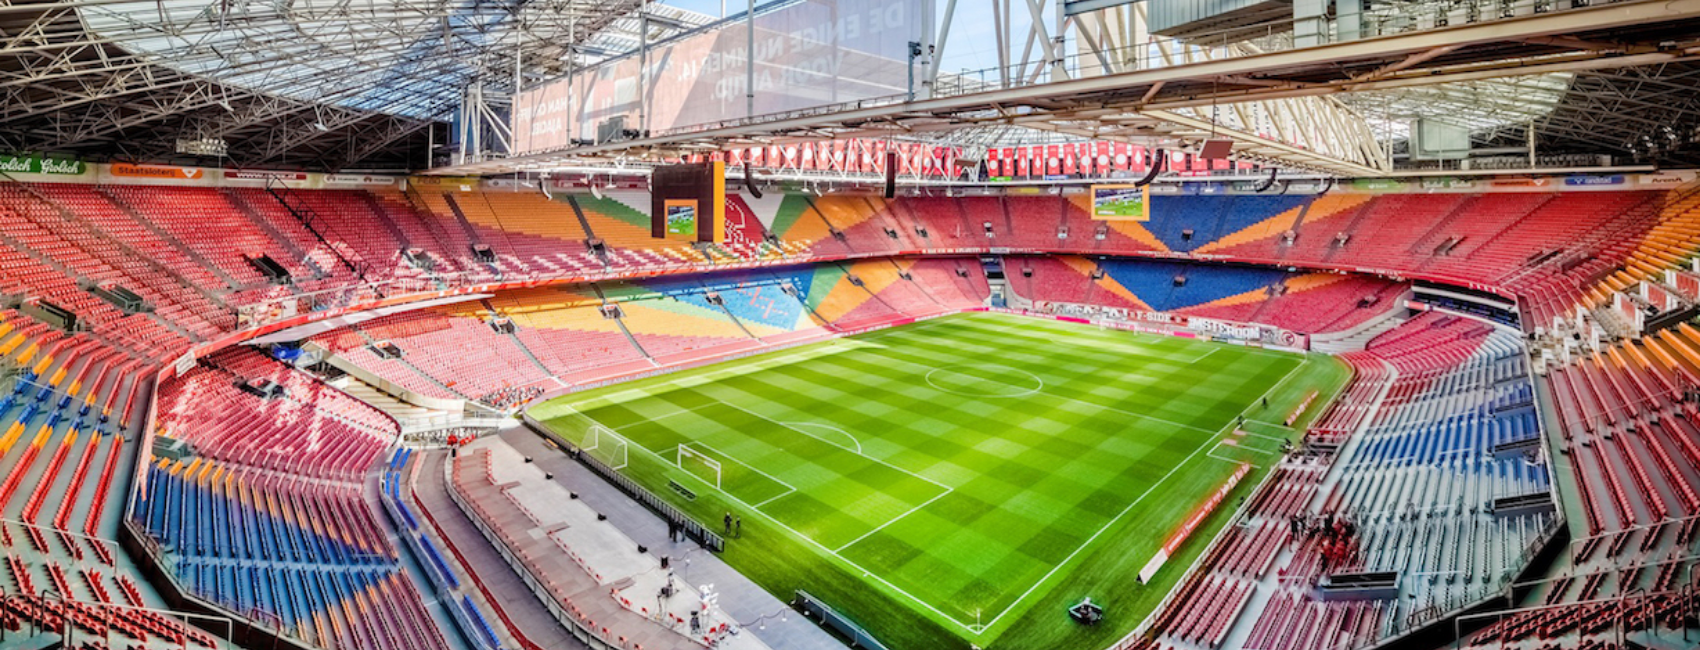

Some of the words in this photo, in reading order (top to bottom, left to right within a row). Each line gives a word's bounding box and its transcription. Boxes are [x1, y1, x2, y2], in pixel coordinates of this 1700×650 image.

[0, 156, 31, 173] olsch
[39, 157, 79, 175] Grolsch
[118, 165, 176, 177] Staatsloterij
